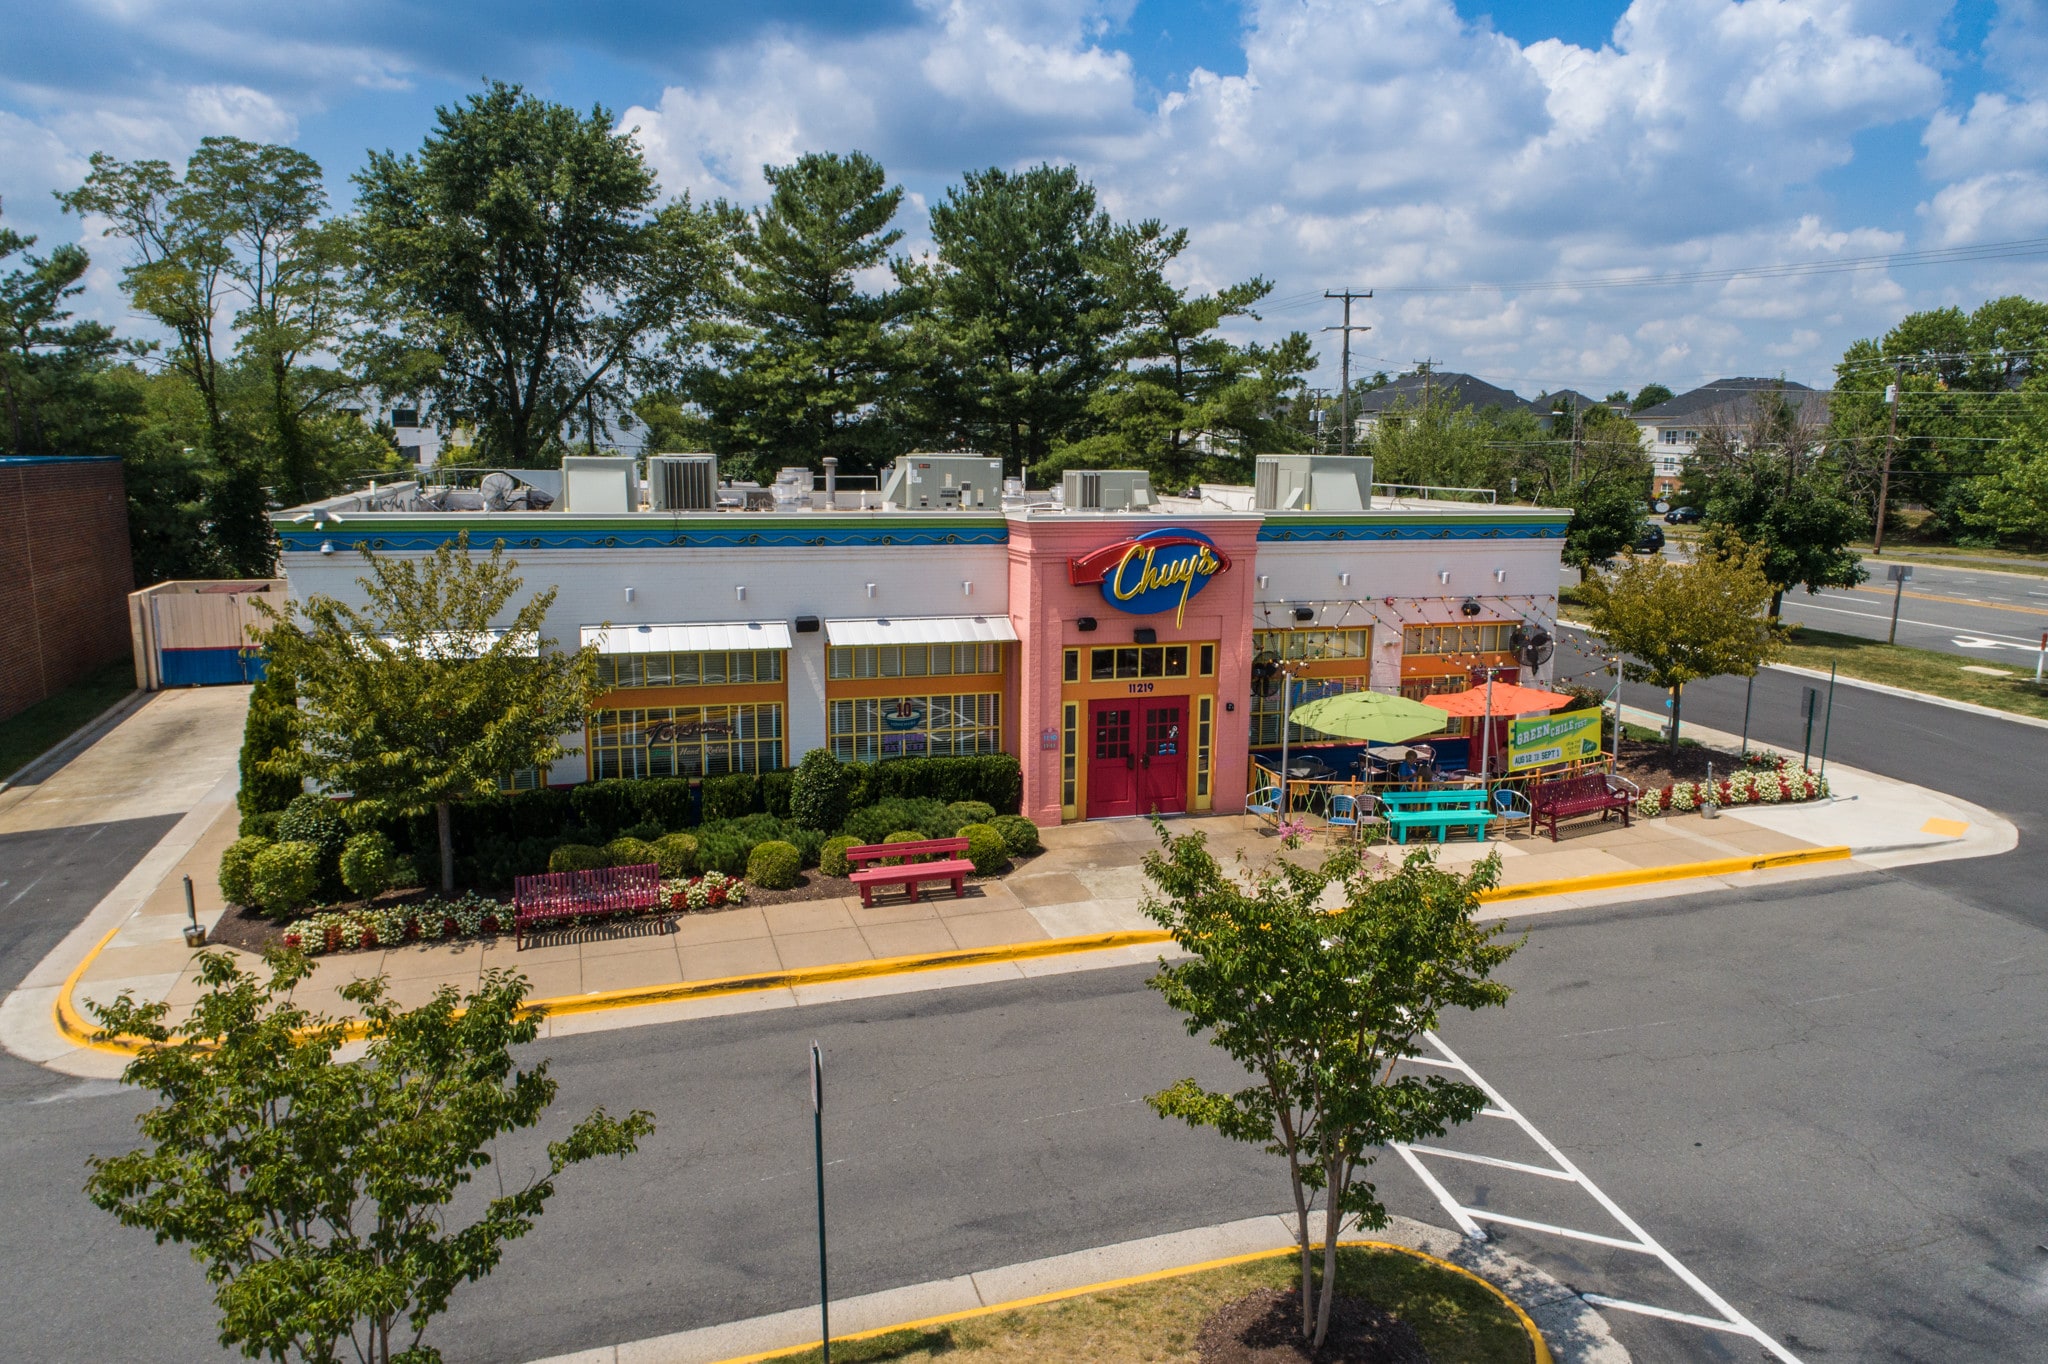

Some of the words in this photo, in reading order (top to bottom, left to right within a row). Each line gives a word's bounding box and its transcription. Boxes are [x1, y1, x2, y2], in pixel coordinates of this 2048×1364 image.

[1113, 544, 1220, 630] Chuy's
[1129, 683, 1154, 693] 11219
[896, 702, 912, 717] 10
[1517, 723, 1550, 745] GREEN
[1550, 720, 1574, 737] CHILE
[1574, 718, 1588, 730] FEST
[1514, 756, 1525, 765] AUG
[1525, 754, 1532, 763] 12
[1541, 750, 1556, 760] SEPT
